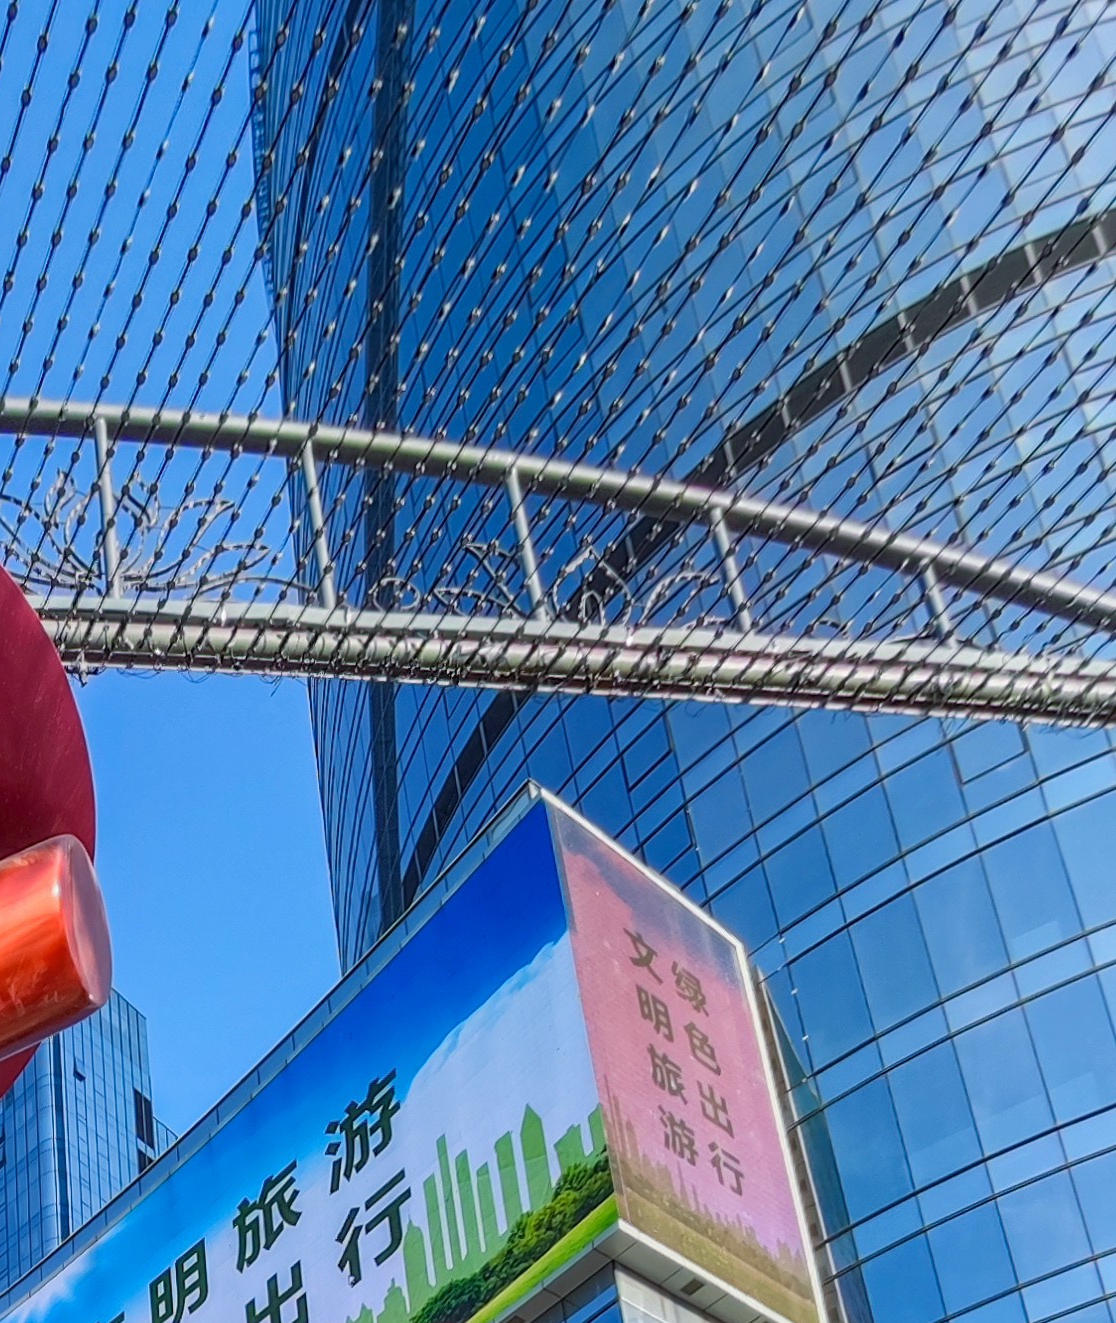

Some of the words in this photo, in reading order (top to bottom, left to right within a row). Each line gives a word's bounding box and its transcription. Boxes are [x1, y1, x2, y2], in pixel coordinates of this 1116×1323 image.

[624, 925, 699, 1168] 文明旅游
[670, 959, 746, 1204] 绿色出行
